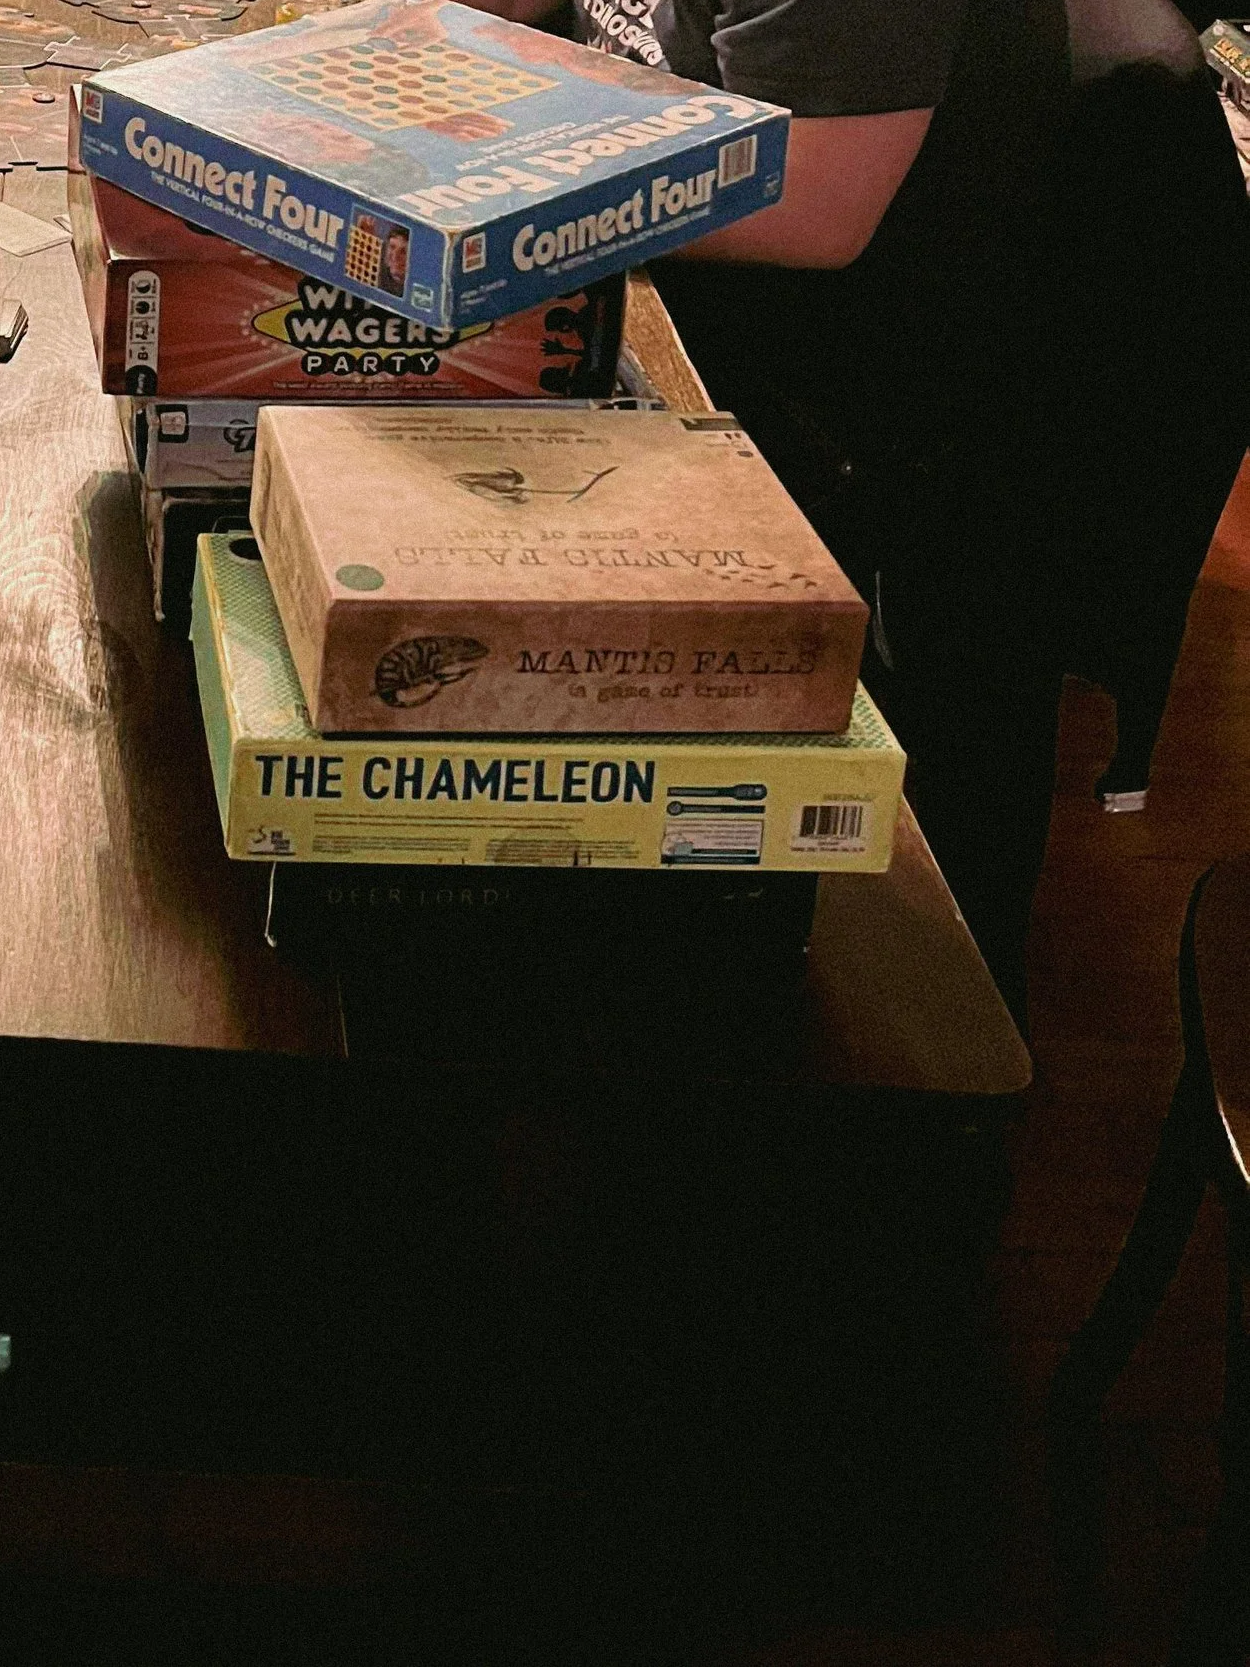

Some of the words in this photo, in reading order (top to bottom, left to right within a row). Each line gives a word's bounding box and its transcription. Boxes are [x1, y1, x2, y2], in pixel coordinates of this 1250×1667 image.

[524, 95, 756, 176] Connect
[125, 117, 257, 210] Connect
[263, 175, 344, 248] Four
[400, 165, 561, 215] Four
[512, 188, 645, 272] Connect
[651, 169, 719, 223] Four
[307, 356, 435, 372] PARTY
[395, 546, 548, 567] FALLS
[564, 547, 747, 568] MANTIS
[517, 649, 676, 675] MANTIS
[691, 649, 818, 675] FALLS
[597, 686, 651, 702] game
[659, 683, 684, 699] of
[255, 755, 343, 799] THE
[363, 756, 655, 803] CHAMELEON
